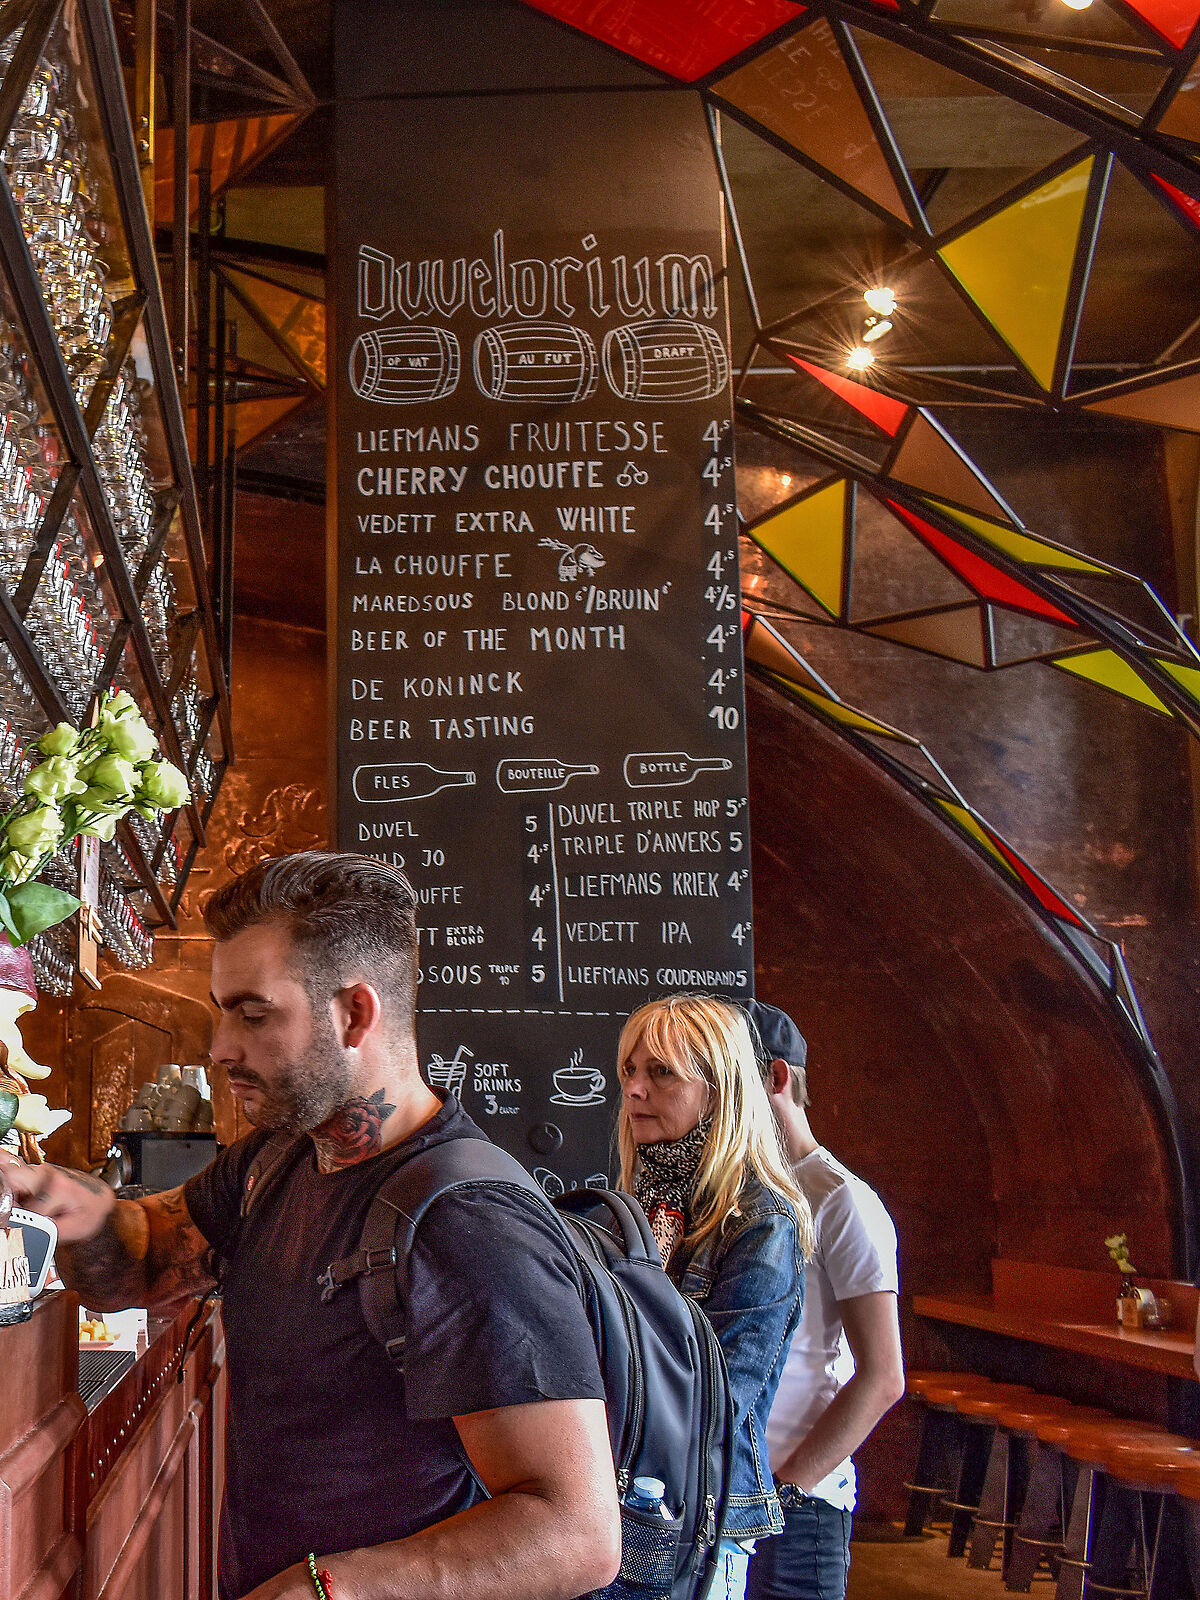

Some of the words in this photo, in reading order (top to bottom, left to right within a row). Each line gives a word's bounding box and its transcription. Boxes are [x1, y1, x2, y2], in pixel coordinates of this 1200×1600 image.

[356, 228, 720, 320] Duvelorium
[406, 356, 430, 368] VAT
[518, 353, 536, 365] AU
[544, 352, 573, 365] FUT
[653, 347, 695, 360] DRAFT
[357, 424, 480, 454] LIEFMANS
[509, 420, 669, 454] FRUITESSE
[356, 465, 468, 497] CHERRY
[484, 460, 604, 490] CHOUFFE
[357, 513, 437, 535] VEDETT
[455, 510, 535, 533] EXTRA
[556, 505, 636, 534] WHITE
[355, 556, 383, 575] LA
[394, 552, 513, 580] CHOUFFE
[352, 592, 474, 613] MAREDSOUS
[351, 629, 409, 652] BEER
[423, 630, 447, 648] OF
[462, 628, 507, 652] THE
[530, 624, 626, 653] MONTH
[351, 678, 384, 701] DE
[403, 671, 523, 699] KONINCK
[349, 718, 412, 741] BEER
[429, 715, 534, 740] TASTING
[708, 705, 739, 730] 10
[507, 768, 566, 781] BOUTEILLE
[639, 762, 688, 775] BOTTLE
[374, 775, 411, 790] FLES
[557, 802, 622, 828] DUVEL
[626, 800, 683, 821] TRIPLE
[693, 799, 721, 818] HOP
[358, 820, 419, 842] DUVEL
[525, 815, 538, 833] 5
[561, 833, 625, 856] TRIPLE
[729, 831, 743, 853] 5
[421, 849, 445, 867] JO
[564, 872, 662, 898] LIEFMANS
[672, 871, 720, 898] KRIEK
[446, 925, 485, 936] EXTRA
[531, 926, 547, 951] 4
[446, 935, 484, 947] BLOND
[565, 920, 640, 943] VEDETT
[662, 921, 692, 944] IPA
[488, 964, 520, 974] TRIPLE
[531, 964, 546, 983] 5
[567, 965, 650, 986] LIEFMANS
[654, 965, 737, 988] GOUDENBAND
[474, 1062, 509, 1078] SOFT
[473, 1078, 522, 1093] DRINKS
[484, 1094, 499, 1115] 3
